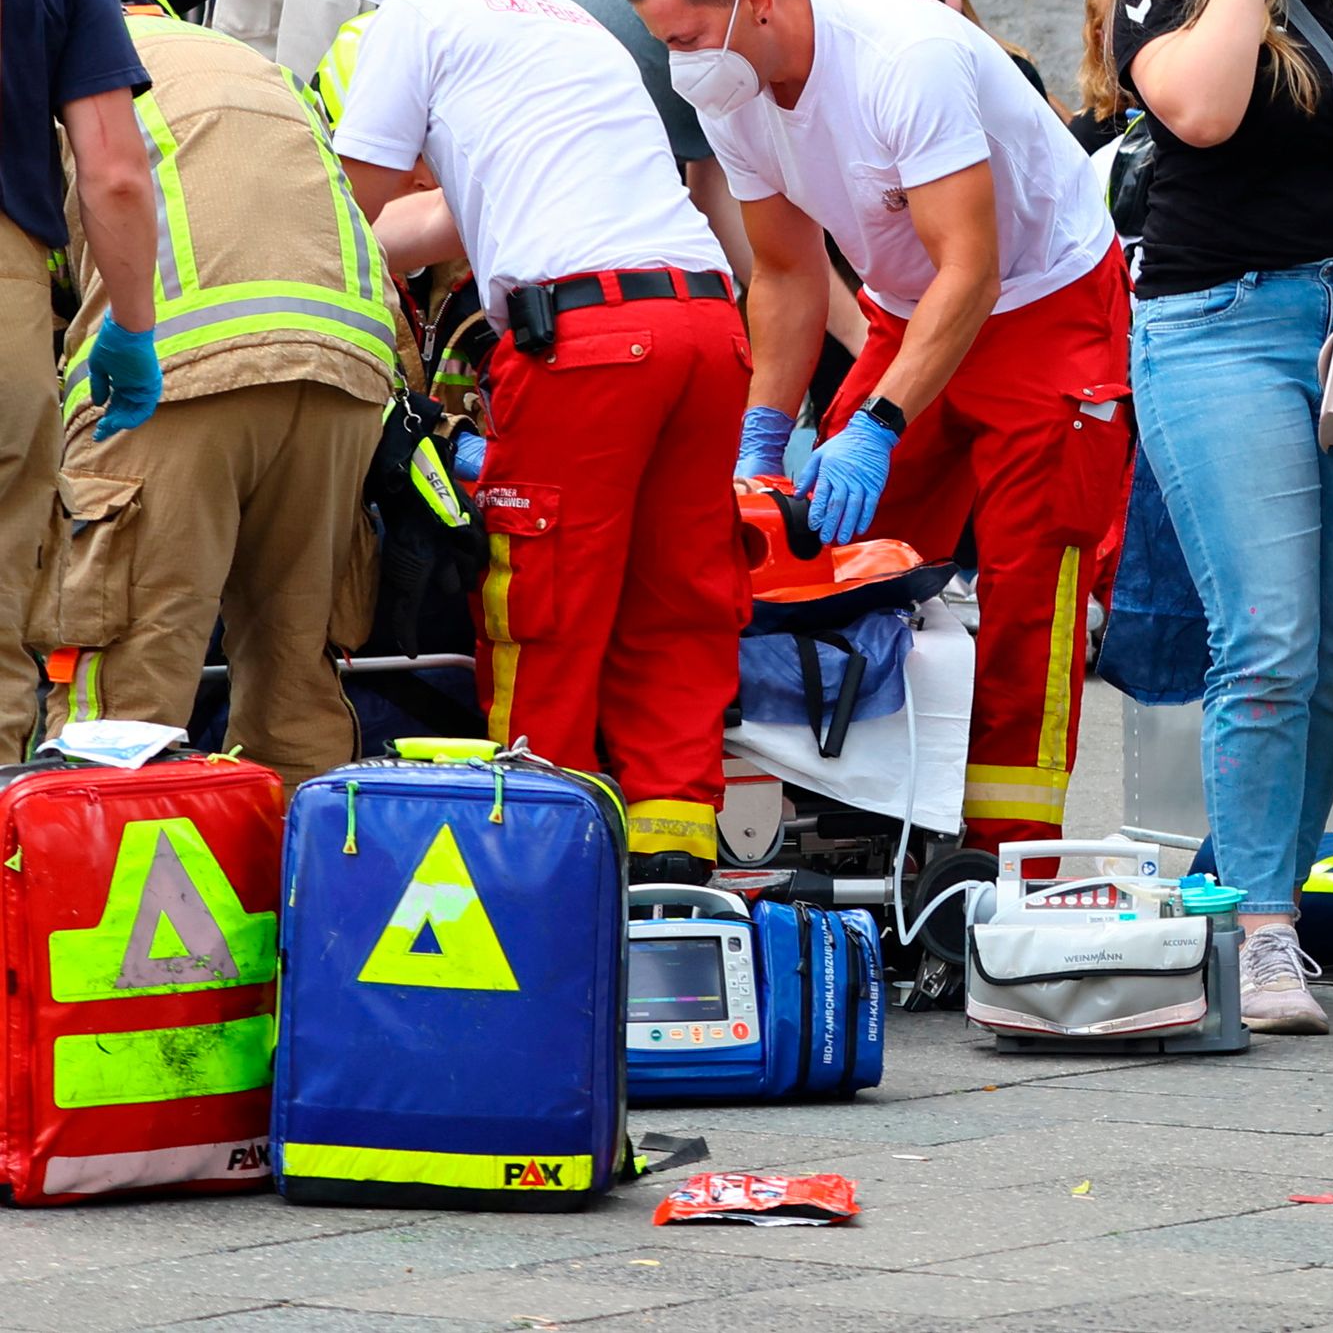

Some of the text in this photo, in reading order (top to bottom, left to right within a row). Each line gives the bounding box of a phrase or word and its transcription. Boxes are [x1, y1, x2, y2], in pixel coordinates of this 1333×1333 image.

[427, 471, 451, 500] SEIZ
[1162, 938, 1198, 947] ACCUVAC
[1063, 949, 1123, 965] WEINMANN
[227, 1142, 271, 1171] PAX
[504, 1159, 563, 1186] PAX
